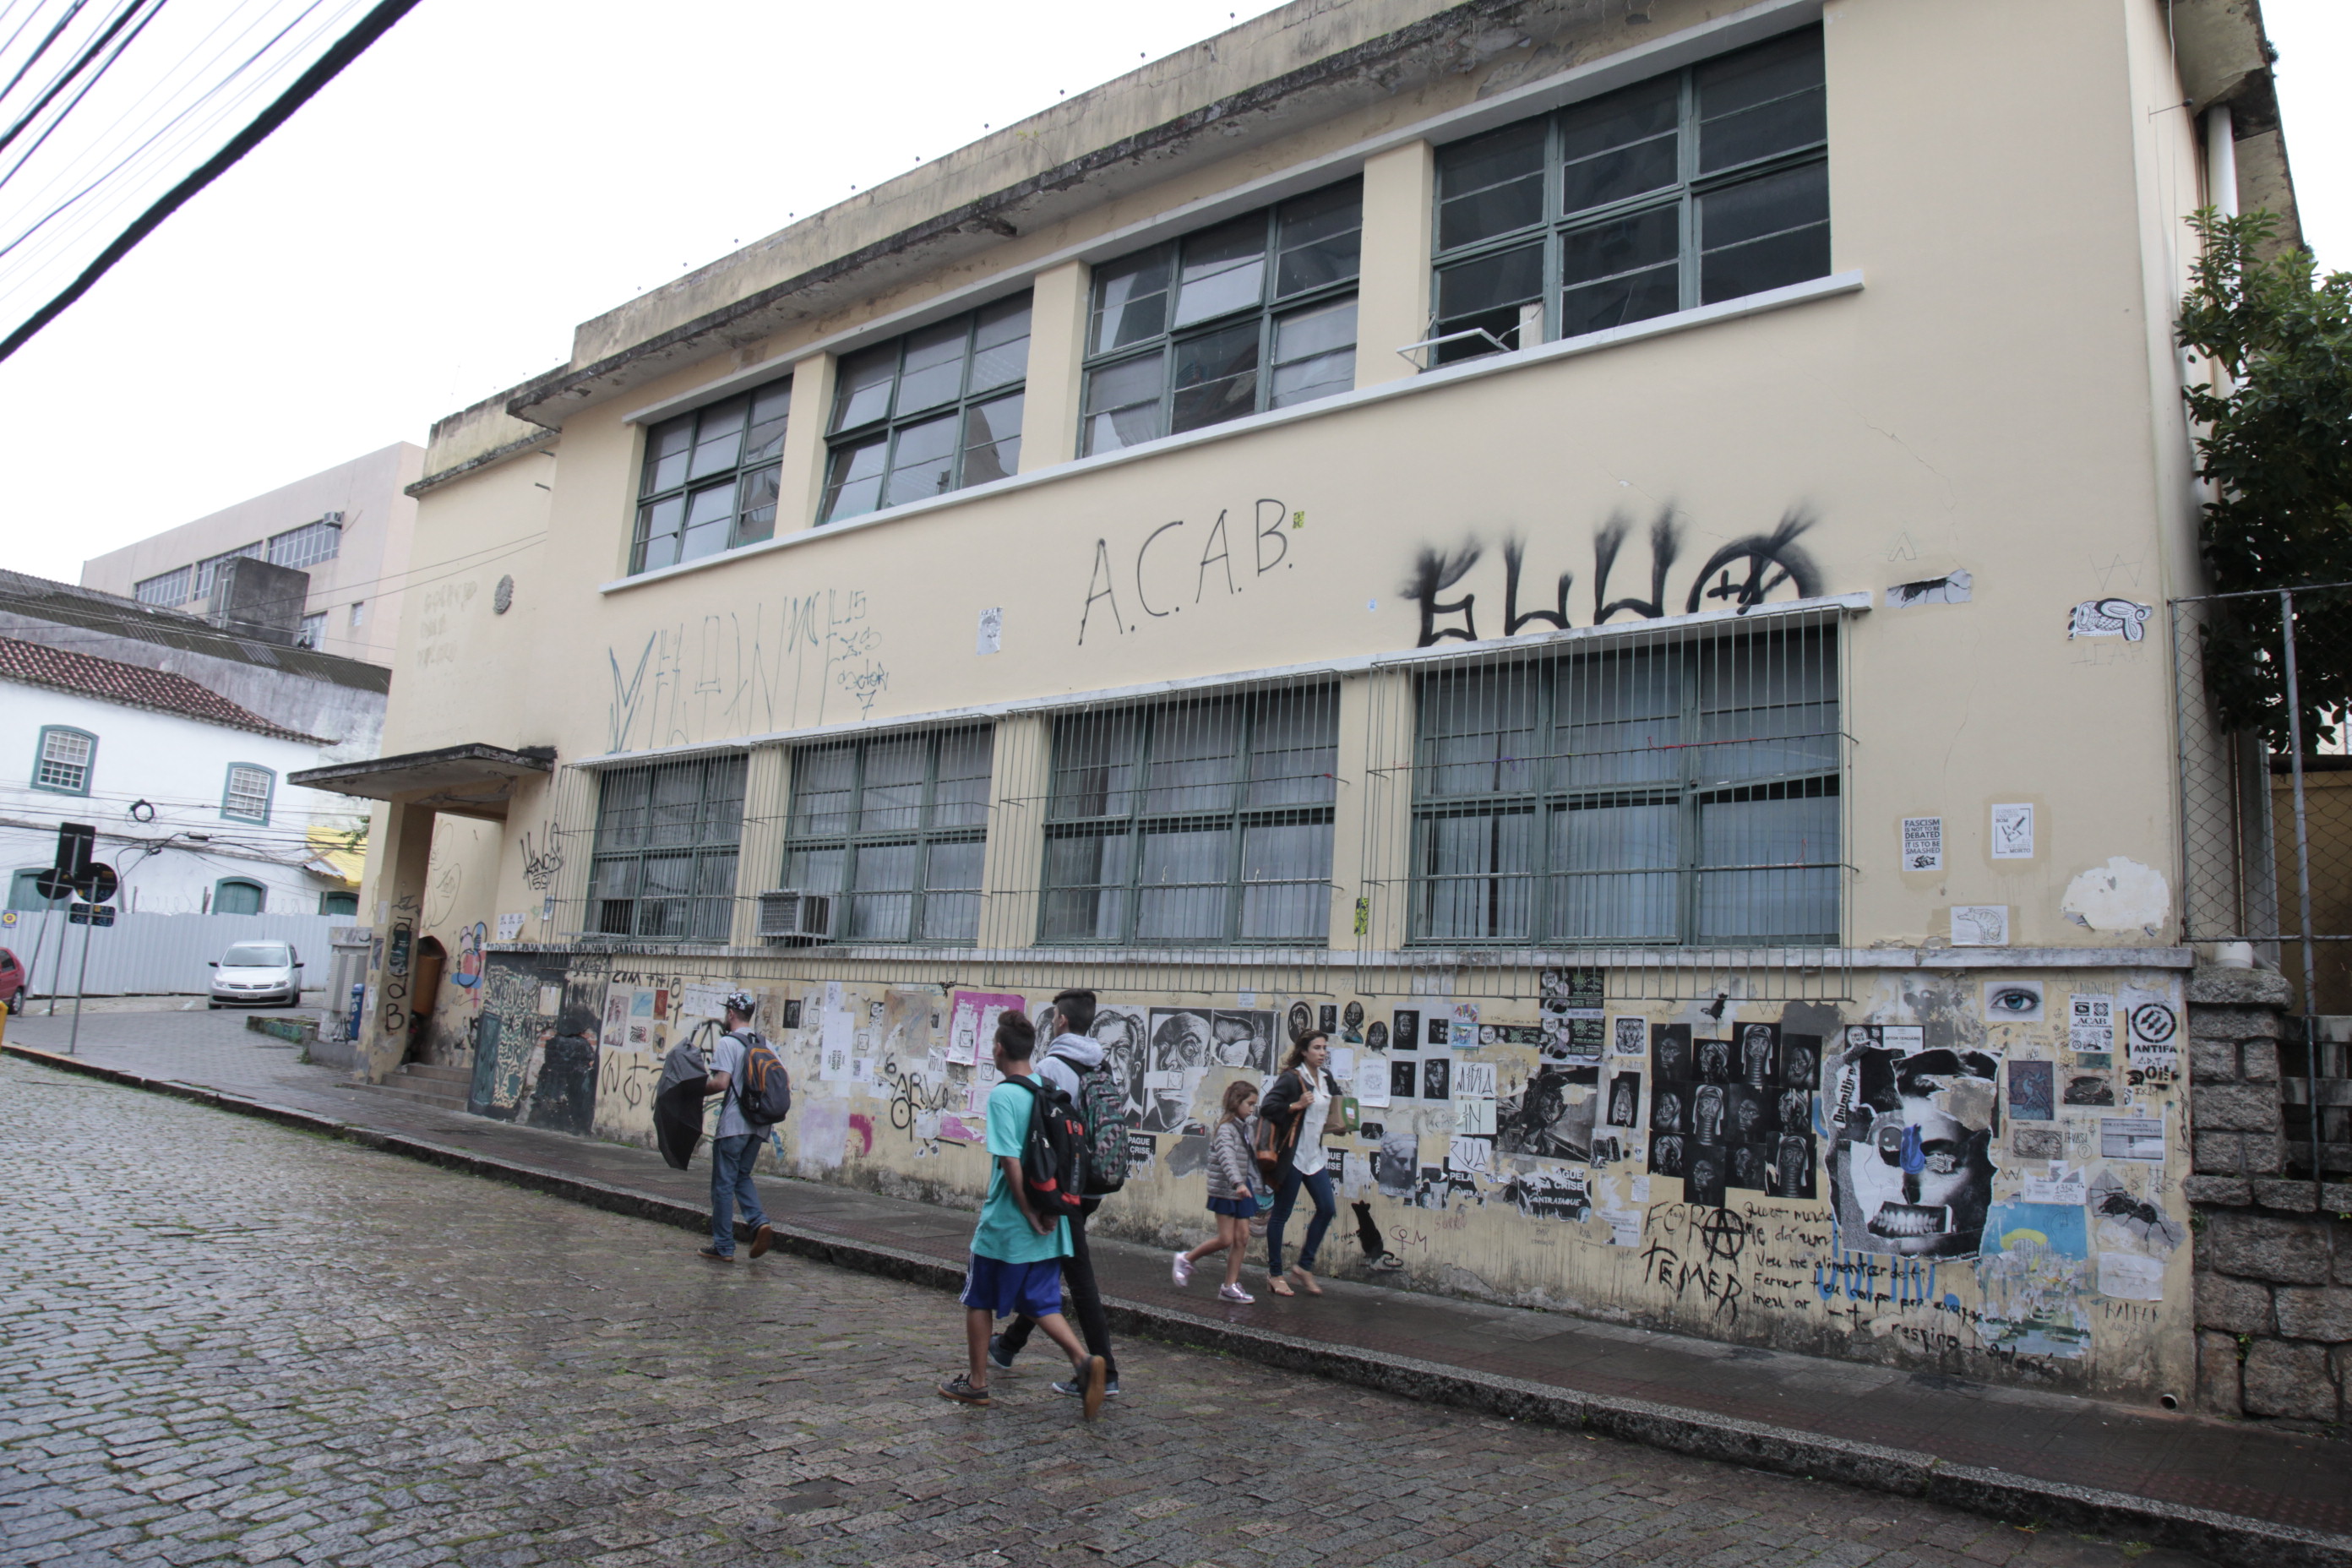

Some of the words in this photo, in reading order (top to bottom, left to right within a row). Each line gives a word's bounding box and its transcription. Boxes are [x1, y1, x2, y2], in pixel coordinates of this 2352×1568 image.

[1904, 819, 1941, 827] FASCISM
[2133, 1044, 2178, 1053] ANTIFA
[1127, 1136, 1151, 1146] PAGUE
[1130, 1145, 1151, 1155] CRISE
[1449, 1173, 1473, 1182] PELA
[1554, 1180, 1585, 1191] CRISE
[1528, 1195, 1582, 1206] CONTRATAQUE
[1641, 1238, 1743, 1326] TEMER
[1753, 1292, 1784, 1308] meu
[1794, 1298, 1811, 1310] ar
[1892, 1323, 1960, 1353] respiro
